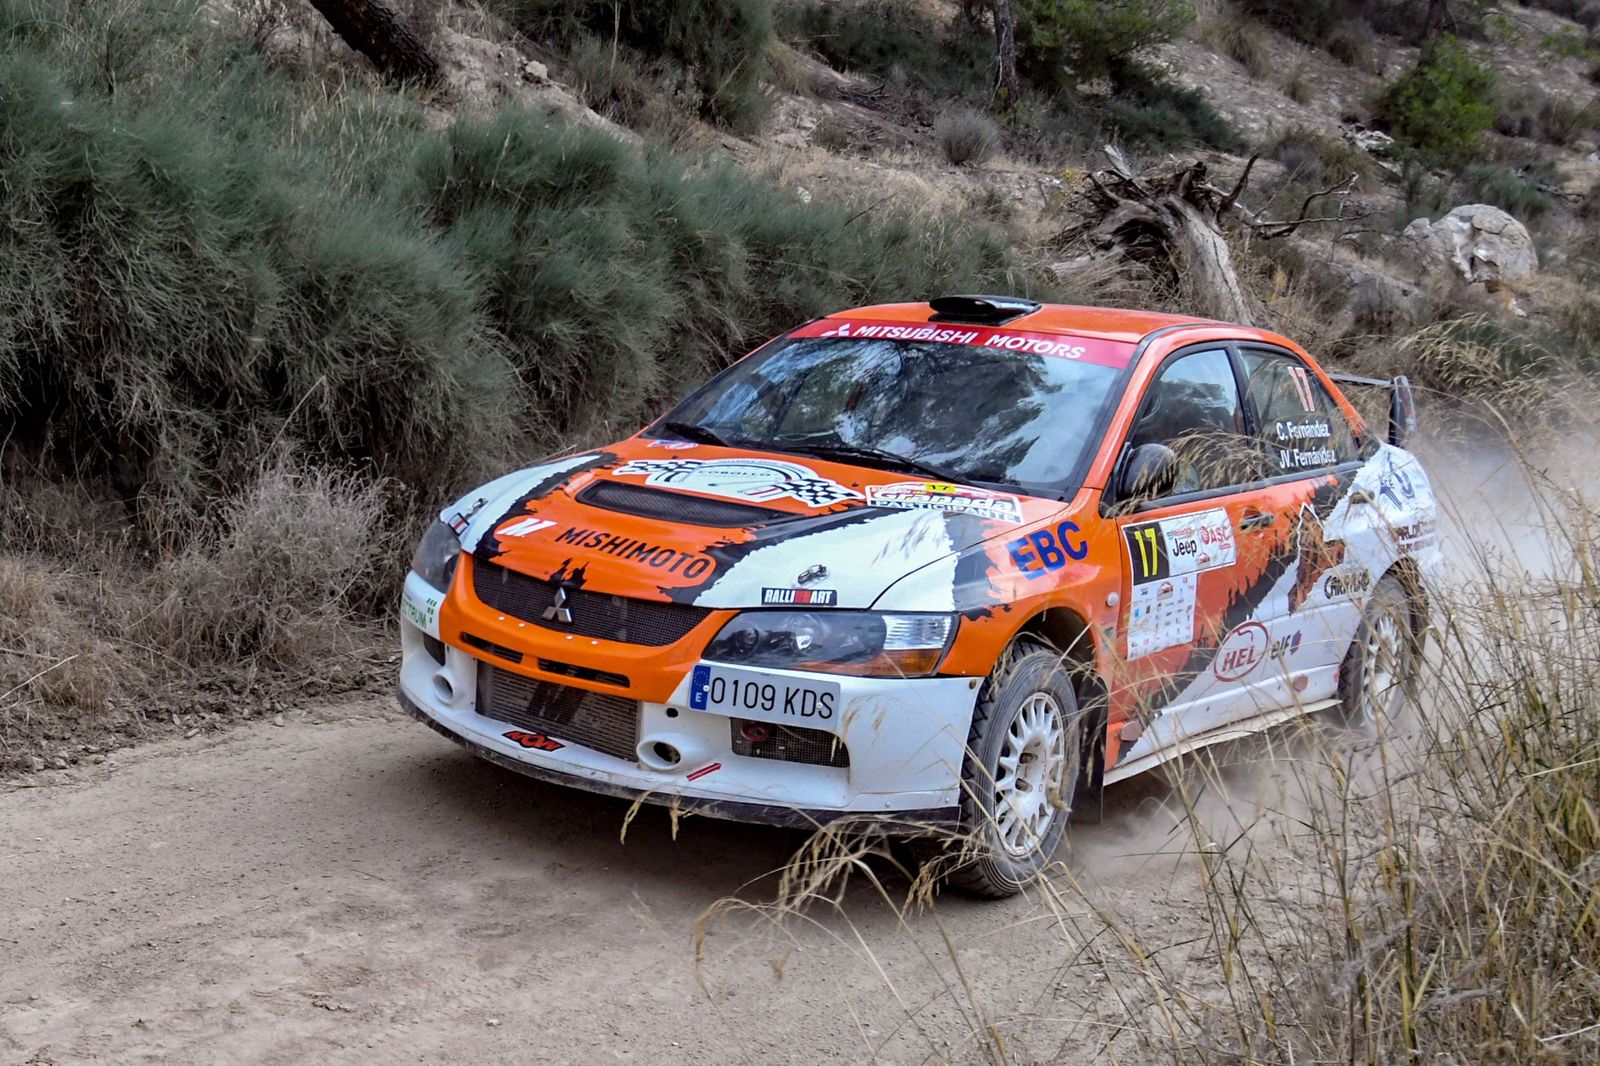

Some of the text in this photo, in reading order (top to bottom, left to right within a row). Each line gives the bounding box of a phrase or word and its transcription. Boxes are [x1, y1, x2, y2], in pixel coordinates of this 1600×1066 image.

[852, 325, 1087, 359] MITSUBISHI MOTORS
[1286, 366, 1316, 412] 17
[1276, 422, 1288, 441] C.
[873, 489, 1013, 511] Granada
[874, 499, 1022, 523] PARTICIPANTE
[555, 527, 711, 579] MISHIMOTO
[1007, 521, 1088, 580] EBC
[1134, 527, 1159, 578] 17
[1173, 538, 1198, 558] Jeep
[1222, 645, 1256, 673] HEL
[695, 692, 703, 703] E
[711, 677, 834, 719] 0109 KDS
